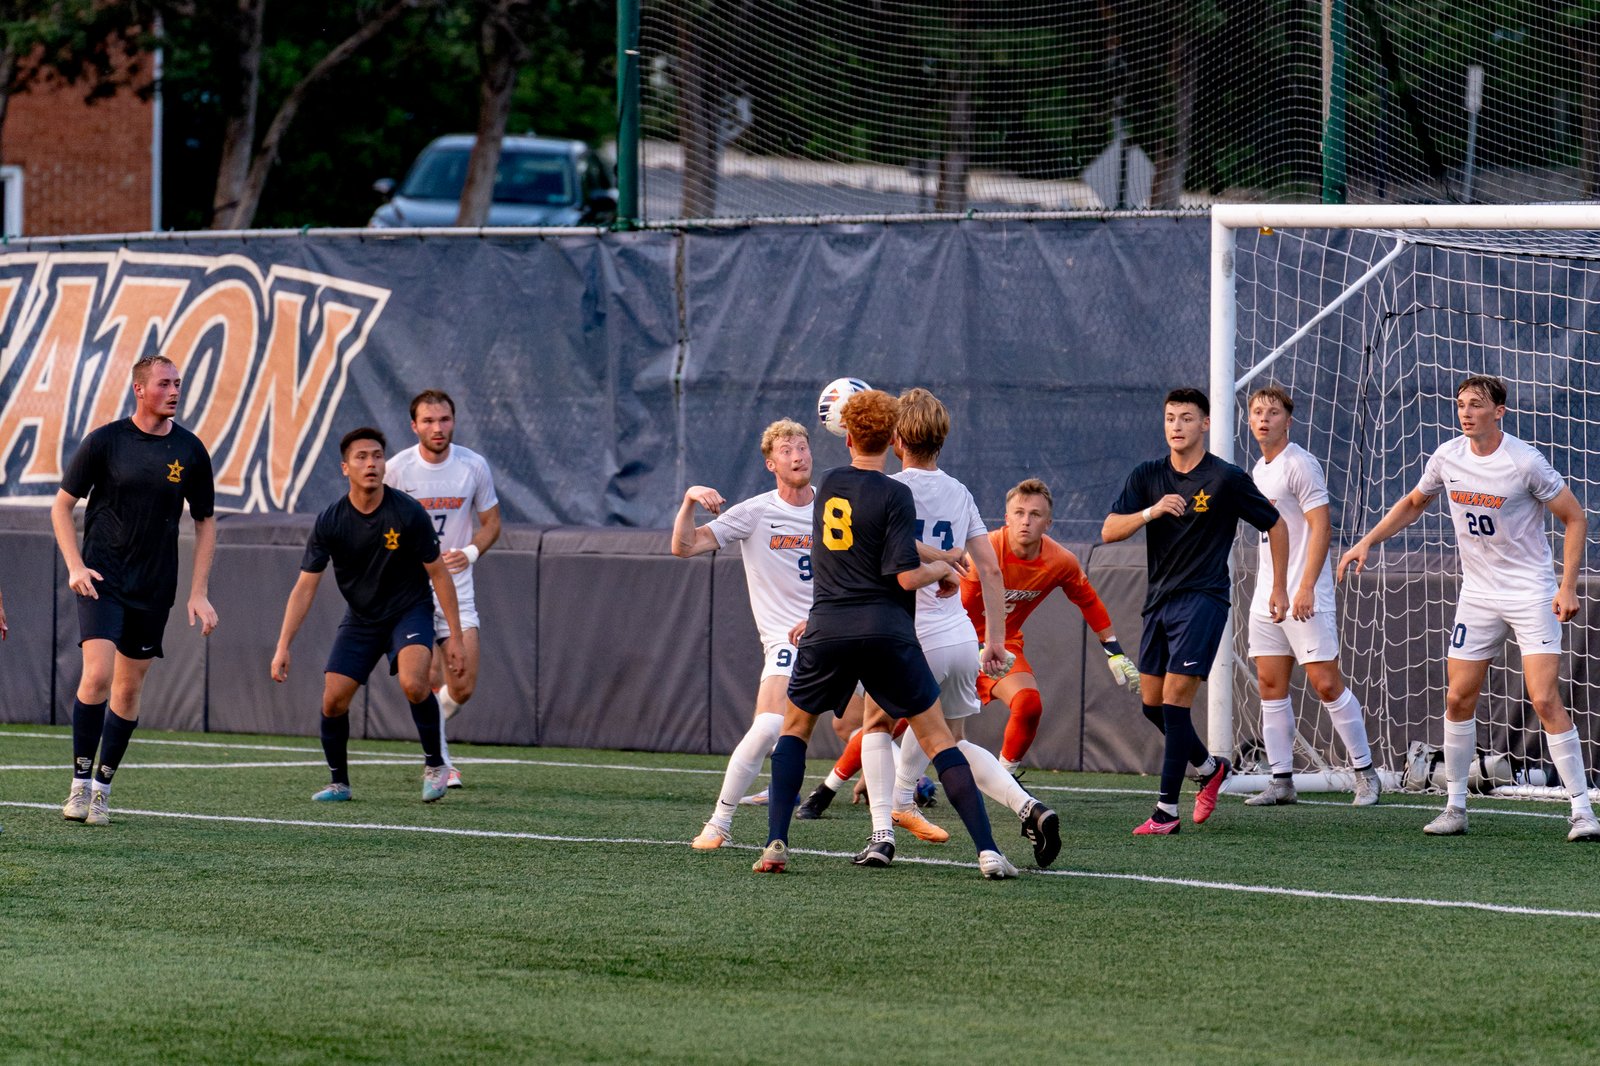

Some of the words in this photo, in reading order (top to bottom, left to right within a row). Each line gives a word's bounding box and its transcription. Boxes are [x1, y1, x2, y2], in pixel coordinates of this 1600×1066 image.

[0, 249, 391, 513] ATON
[434, 514, 447, 536] 7
[823, 497, 853, 551] 8
[1466, 512, 1495, 536] 20
[798, 555, 813, 581] 9
[1451, 623, 1467, 648] 0
[776, 649, 792, 667] 9
